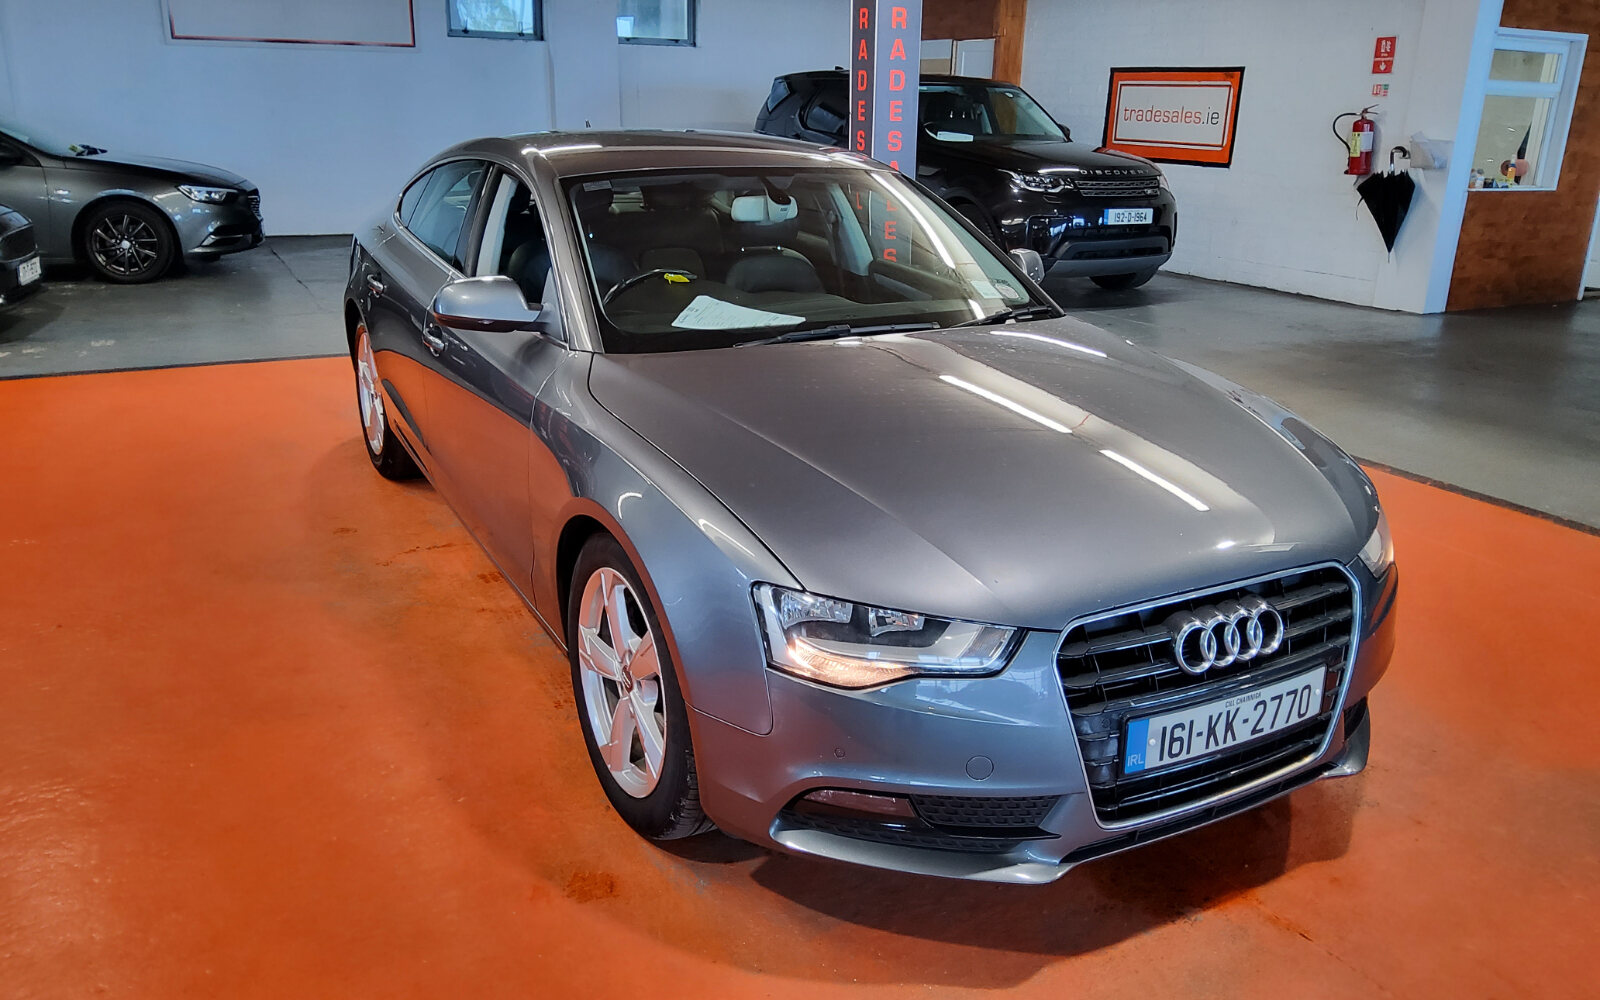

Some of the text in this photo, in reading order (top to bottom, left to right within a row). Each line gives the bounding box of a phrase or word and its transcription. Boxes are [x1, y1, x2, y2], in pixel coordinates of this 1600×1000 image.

[1123, 105, 1220, 125] tradesales.ie
[1114, 211, 1147, 222] 192-D-1964
[1158, 684, 1312, 762] 161-KK-2770
[1127, 753, 1144, 767] IRL
